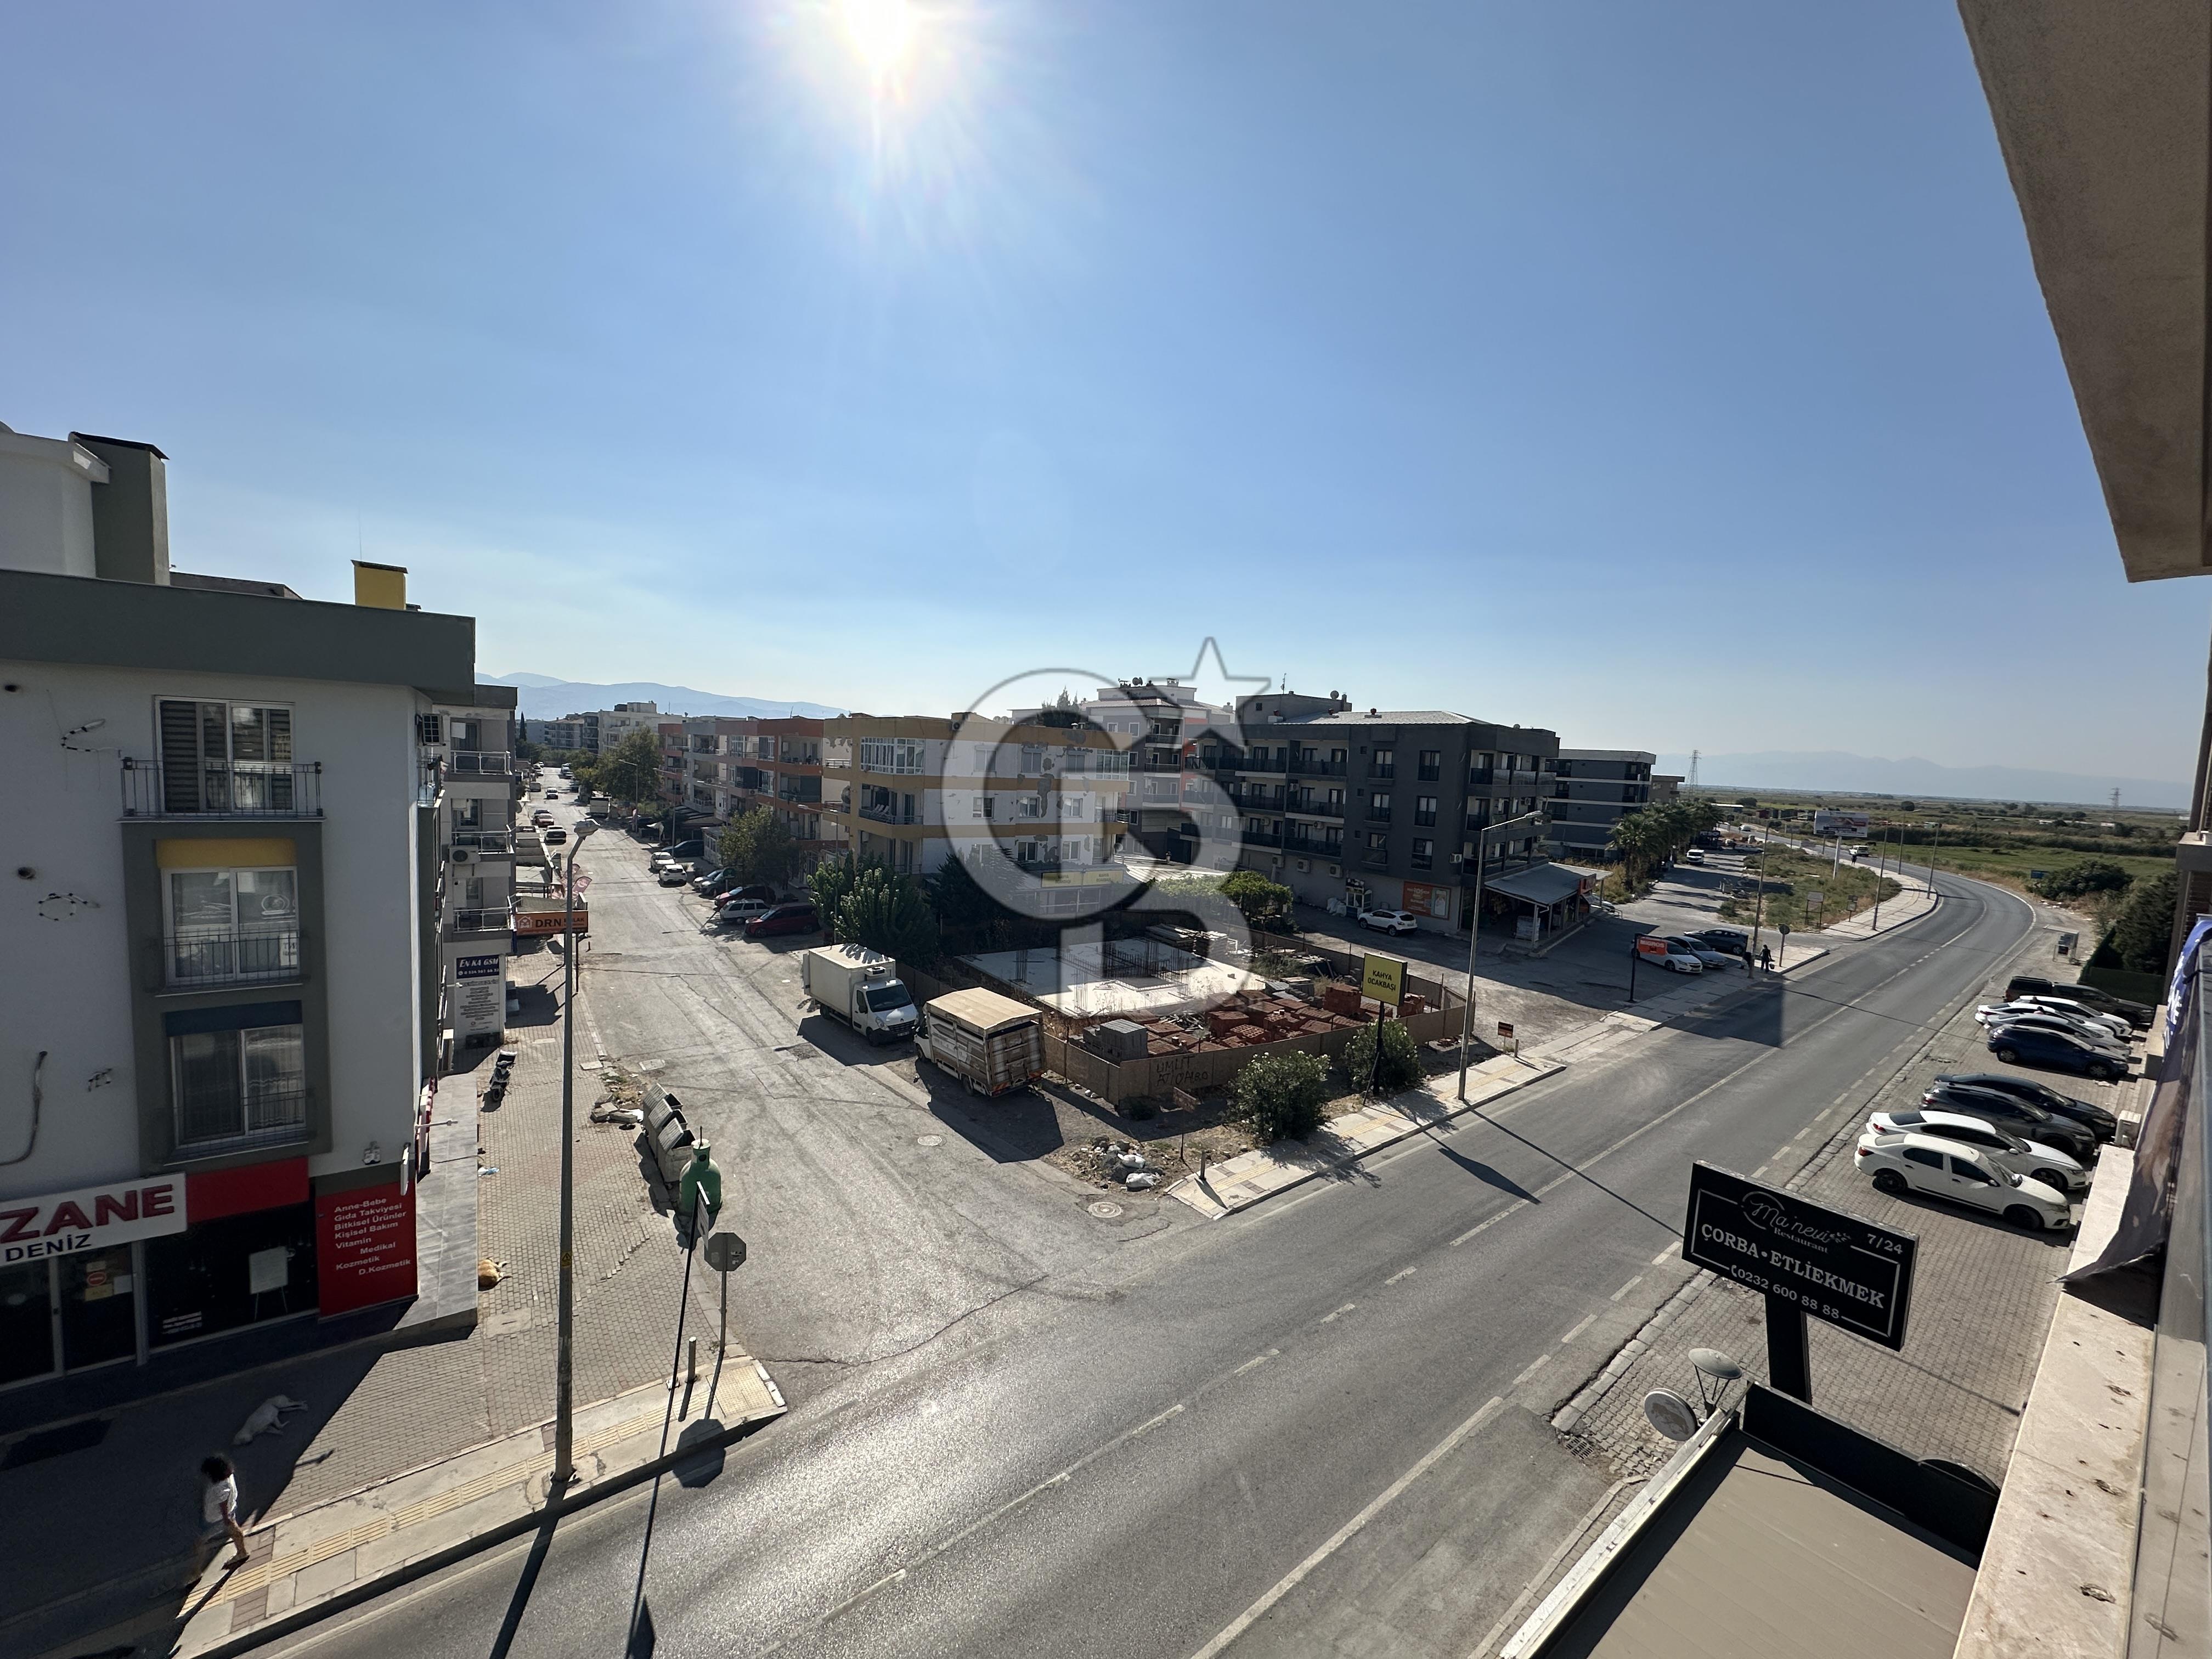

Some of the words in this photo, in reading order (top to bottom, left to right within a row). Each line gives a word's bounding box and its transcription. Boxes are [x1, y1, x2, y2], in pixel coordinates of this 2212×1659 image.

[1640, 939, 1664, 948] MIGROS
[1373, 969, 1392, 981] KAHYA
[1367, 977, 1396, 992] OCAKBAŞI
[334, 1198, 387, 1213] Anne-Bebe
[334, 1213, 357, 1222] Gıda
[359, 1203, 402, 1216] Takviyesi
[334, 1218, 370, 1231] Bitkisel
[373, 1211, 407, 1223] Ürünler
[335, 1227, 367, 1239] Kişisel
[369, 1222, 398, 1232] Bakım
[5, 1234, 92, 1262] DENİZ
[336, 1237, 372, 1249] Vitamin
[360, 1242, 396, 1254] Medikal
[1774, 1227, 1829, 1254] Restaurant
[1867, 1233, 1903, 1255] 7/24
[336, 1255, 380, 1270] Kozmetik
[358, 1259, 411, 1275] D.Kozmetik
[1701, 1223, 1759, 1259] ÇORBA
[1770, 1250, 1885, 1309] ETLİEKMEK
[1738, 1268, 1769, 1289] 0232
[1773, 1284, 1797, 1301] 600
[1801, 1295, 1818, 1311] 88
[1822, 1304, 1839, 1319] 88
